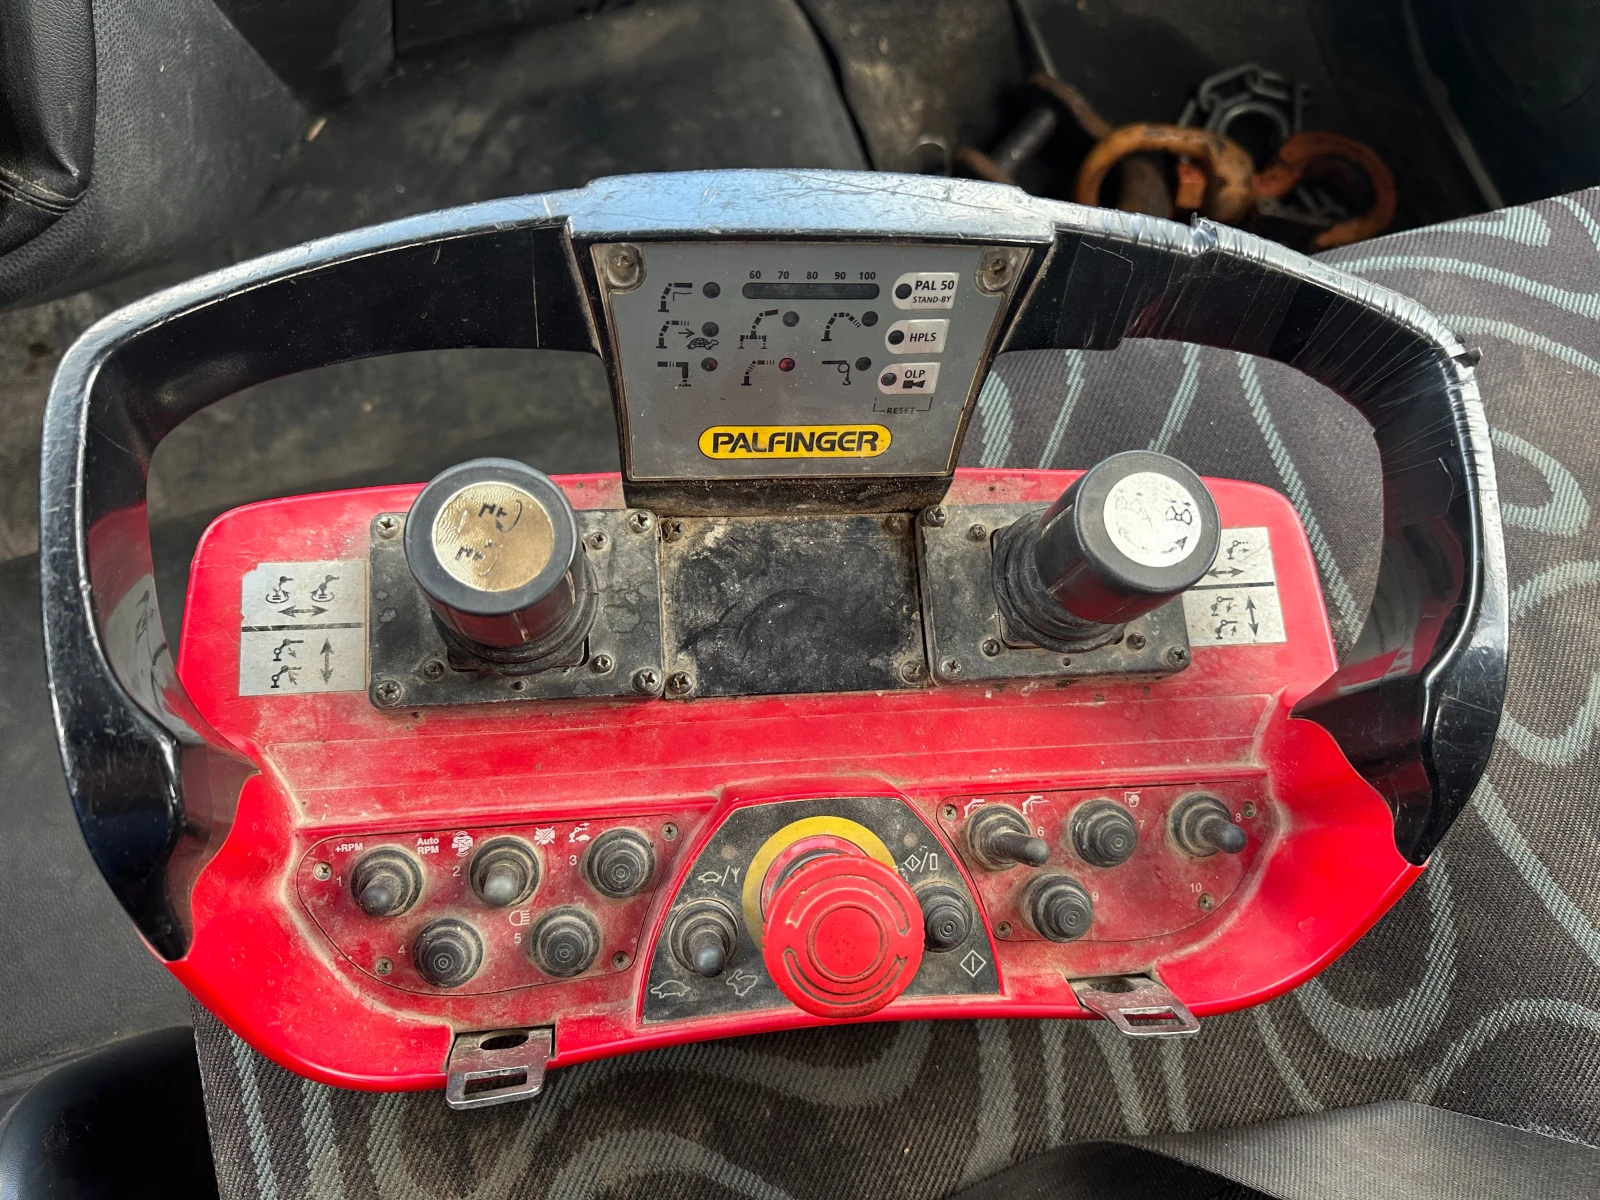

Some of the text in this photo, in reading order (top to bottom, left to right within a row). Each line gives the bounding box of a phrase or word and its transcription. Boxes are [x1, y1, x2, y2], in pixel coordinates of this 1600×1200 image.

[748, 270, 876, 281] 60 70 80 90 100
[914, 280, 955, 291] PAL 50
[912, 295, 952, 304] STAND-BY
[909, 332, 937, 342] HPLS
[904, 369, 926, 379] OLP
[712, 431, 879, 453] PALFINGER
[1234, 812, 1242, 822] 8
[1137, 819, 1145, 830] 7
[1037, 826, 1045, 836] 6
[416, 836, 440, 846] Auto
[335, 842, 364, 853] +RPM
[417, 845, 440, 854] RPM
[568, 855, 578, 867] 3
[452, 866, 461, 878] 2
[336, 876, 344, 888] 1
[1189, 883, 1202, 894] 10
[1091, 892, 1099, 902] 9
[513, 933, 522, 945] 5
[397, 945, 407, 956] 4
